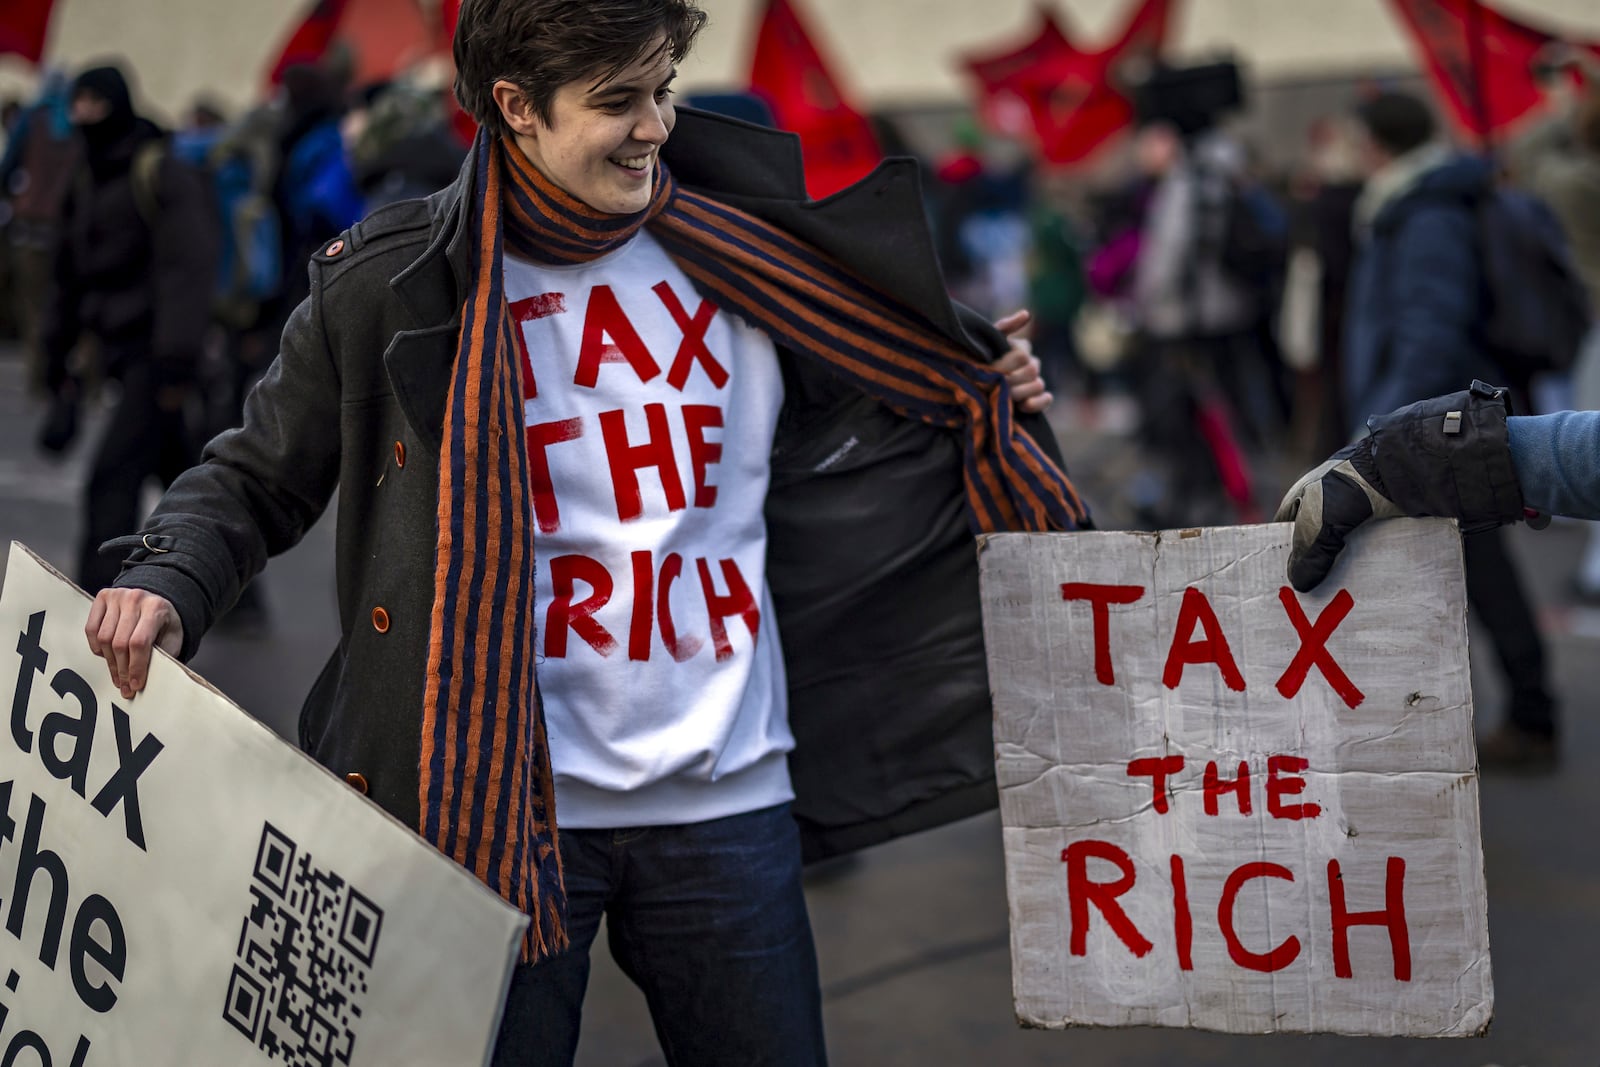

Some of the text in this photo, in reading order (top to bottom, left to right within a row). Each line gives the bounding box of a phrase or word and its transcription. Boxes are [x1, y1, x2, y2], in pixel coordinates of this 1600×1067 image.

[526, 403, 724, 534] THE
[544, 550, 761, 663] RICH
[1061, 582, 1365, 709] TAX
[10, 610, 165, 852] tax
[1126, 755, 1322, 821] THE
[1061, 839, 1412, 982] RICH
